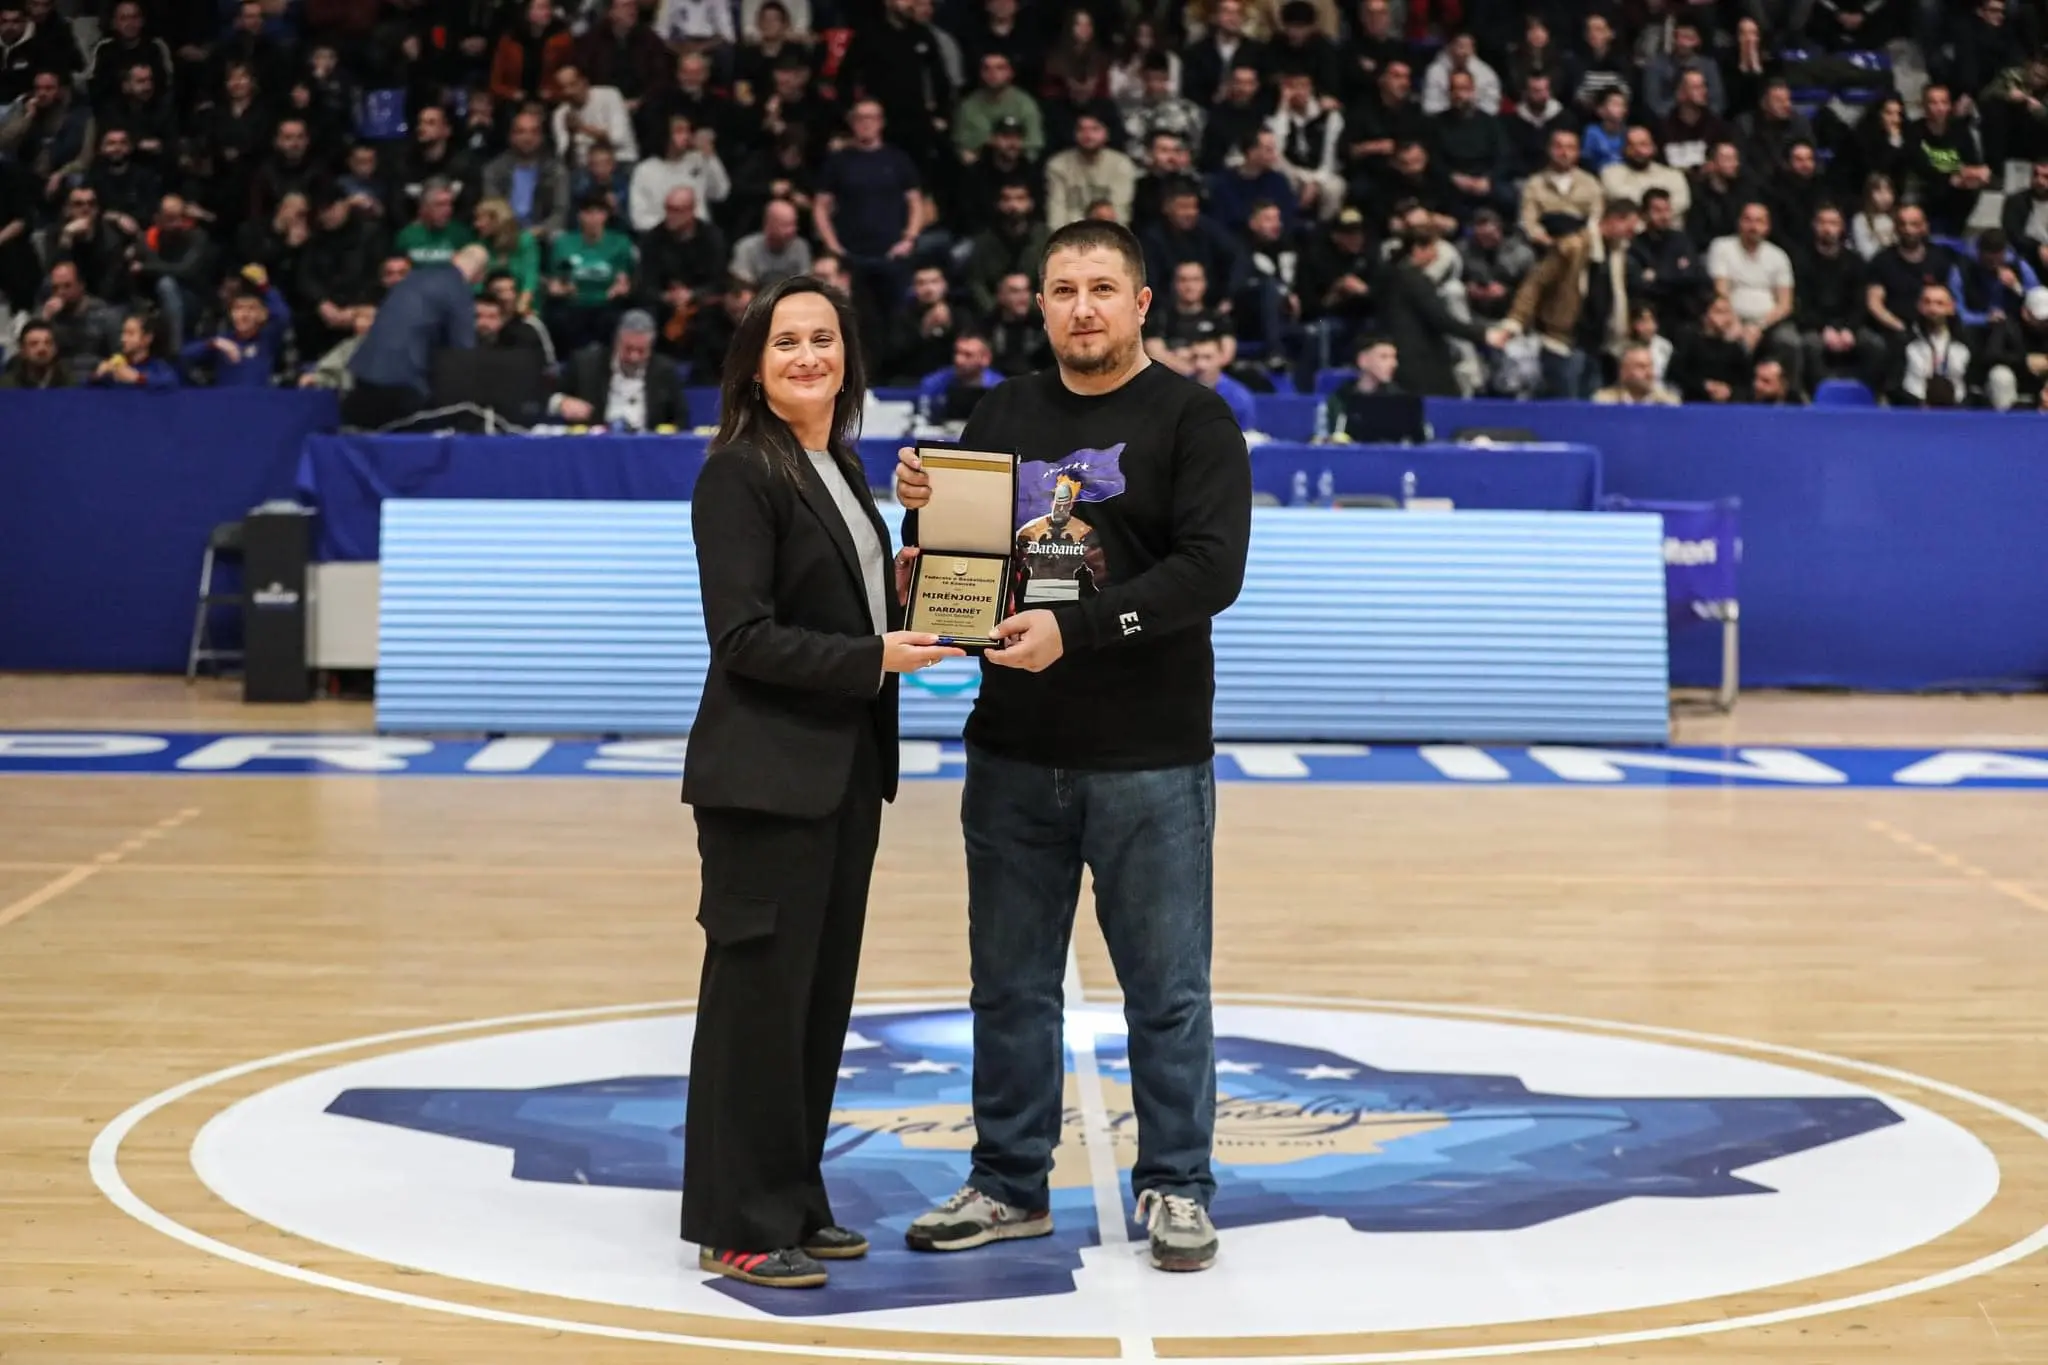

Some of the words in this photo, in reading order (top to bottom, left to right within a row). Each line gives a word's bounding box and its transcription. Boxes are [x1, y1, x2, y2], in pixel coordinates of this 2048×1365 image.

[1027, 541, 1085, 556] Dardanët
[922, 592, 993, 603] MIRËNJOHJE
[0, 735, 2048, 785] PRISTINA
